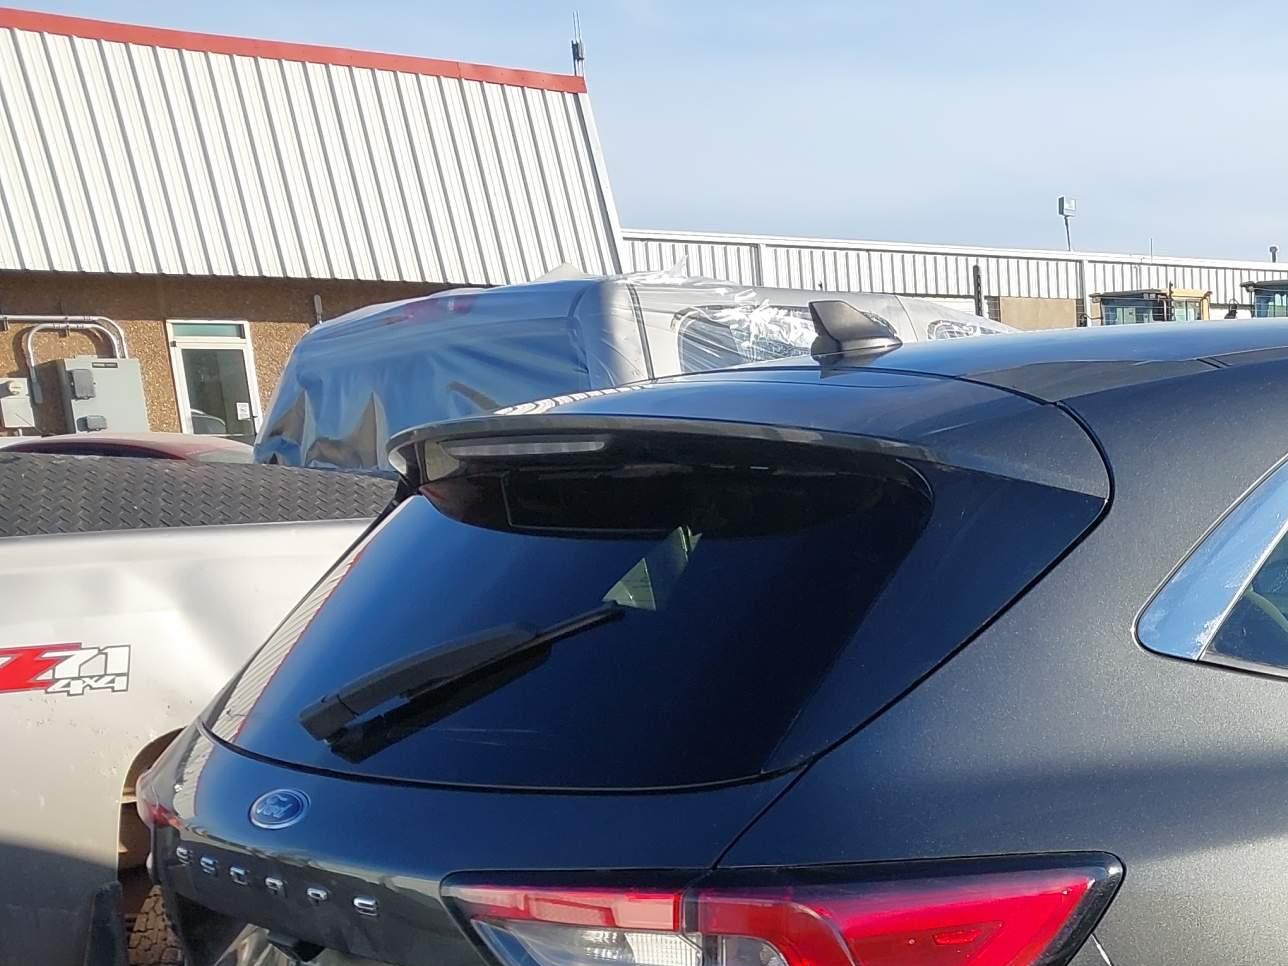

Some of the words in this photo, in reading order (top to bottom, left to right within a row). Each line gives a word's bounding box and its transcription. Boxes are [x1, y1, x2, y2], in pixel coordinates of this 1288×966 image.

[0, 642, 131, 694] Z71
[256, 794, 293, 818] Ford
[175, 846, 380, 917] ESCAPE
